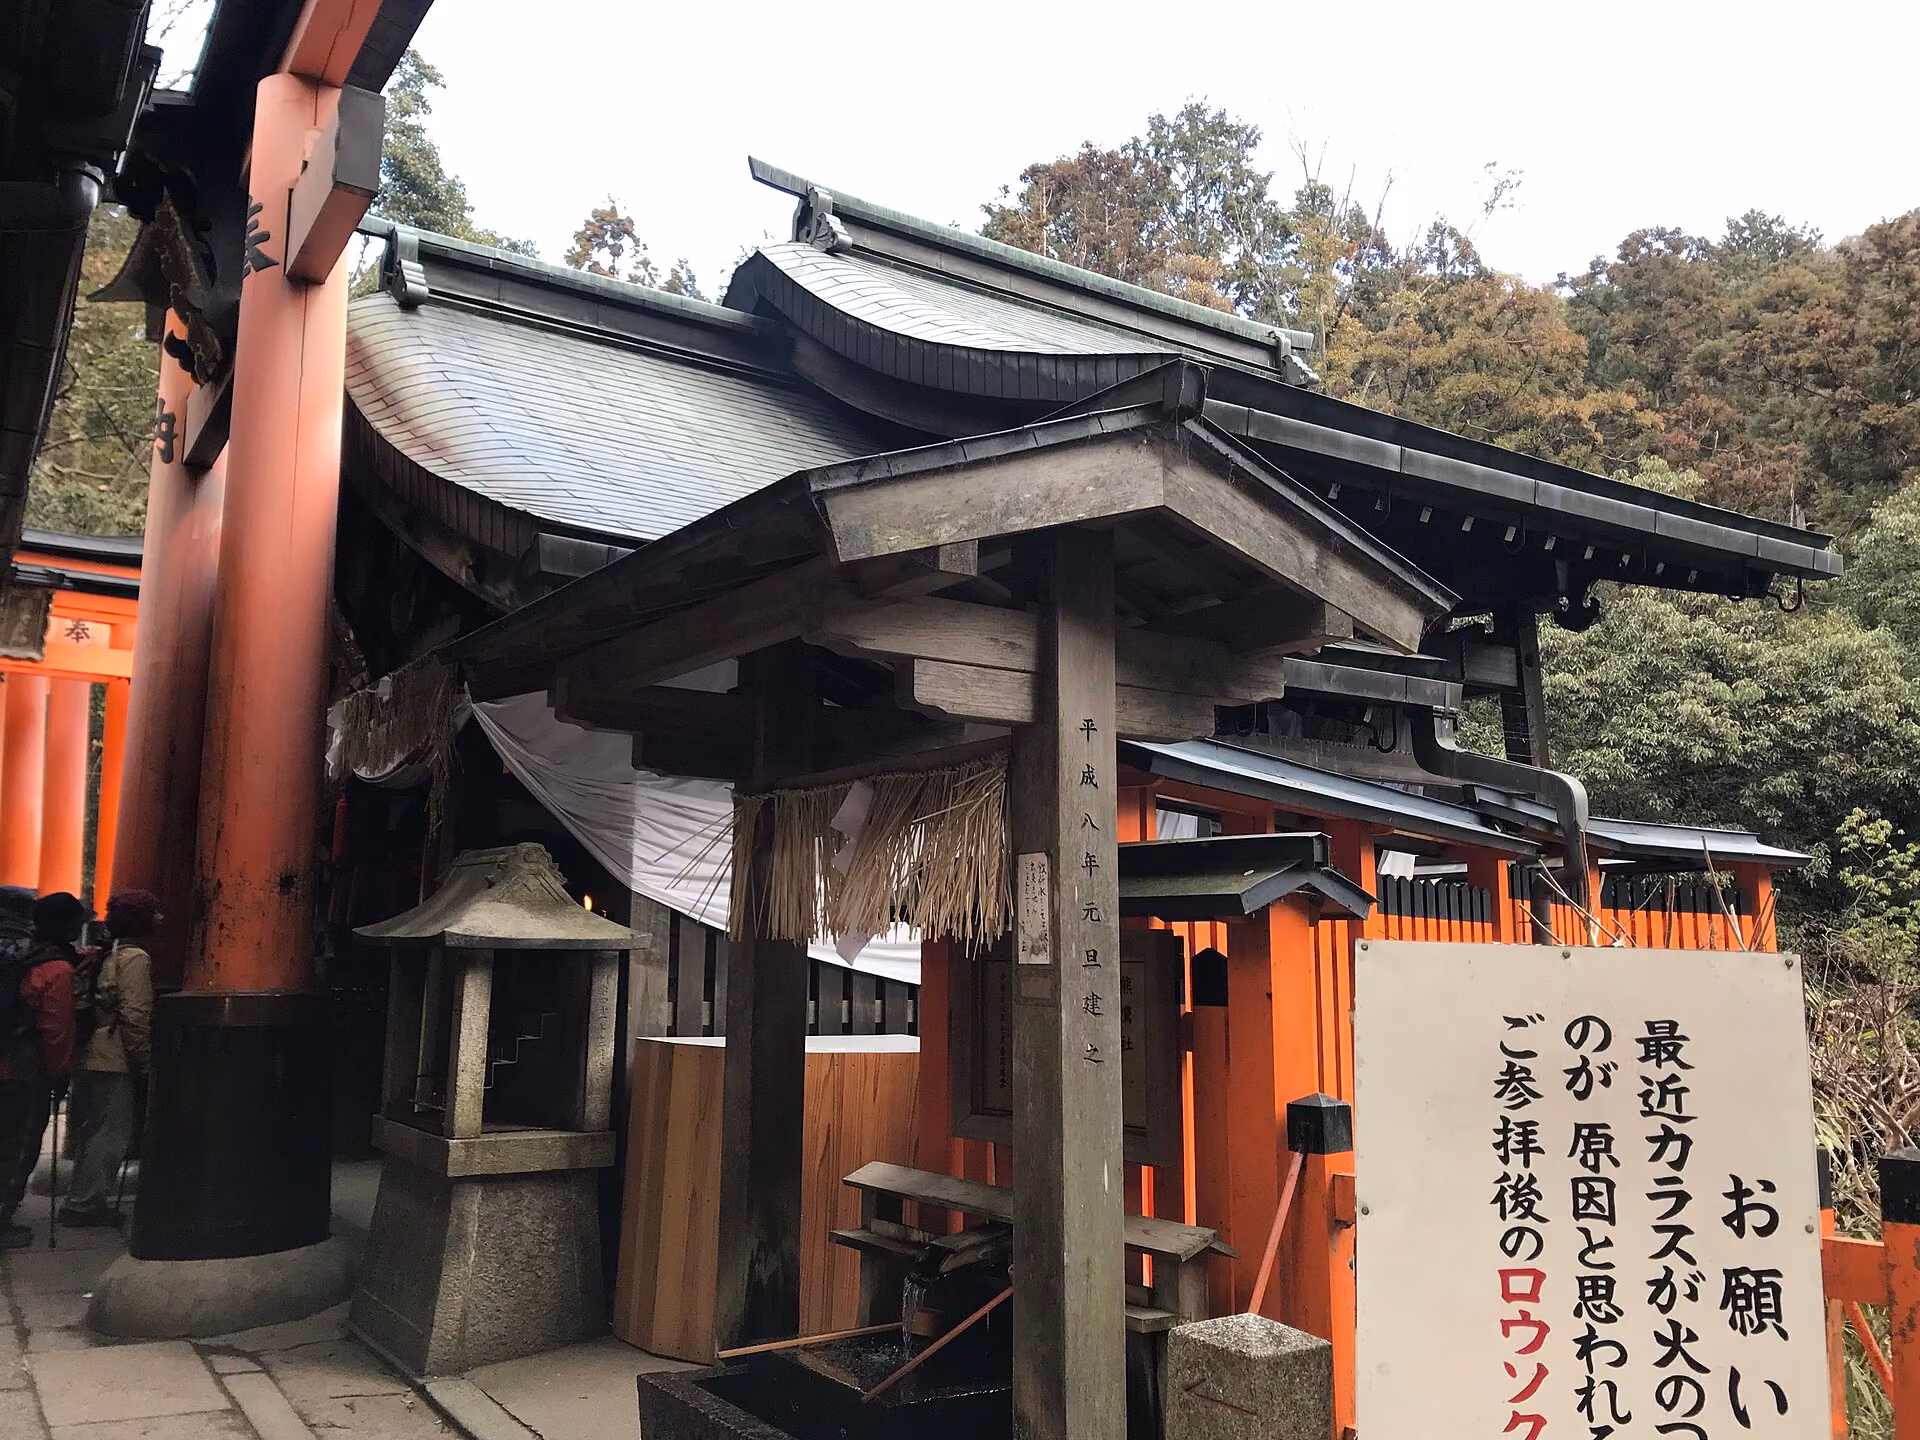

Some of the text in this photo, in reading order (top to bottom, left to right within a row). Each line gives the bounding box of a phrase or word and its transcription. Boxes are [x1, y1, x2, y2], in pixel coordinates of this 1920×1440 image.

[1079, 719, 1104, 1063] 平成八年元旦建之
[1562, 1015, 1633, 1440] のが原因と思われ
[1719, 1173, 1789, 1430] お願い
